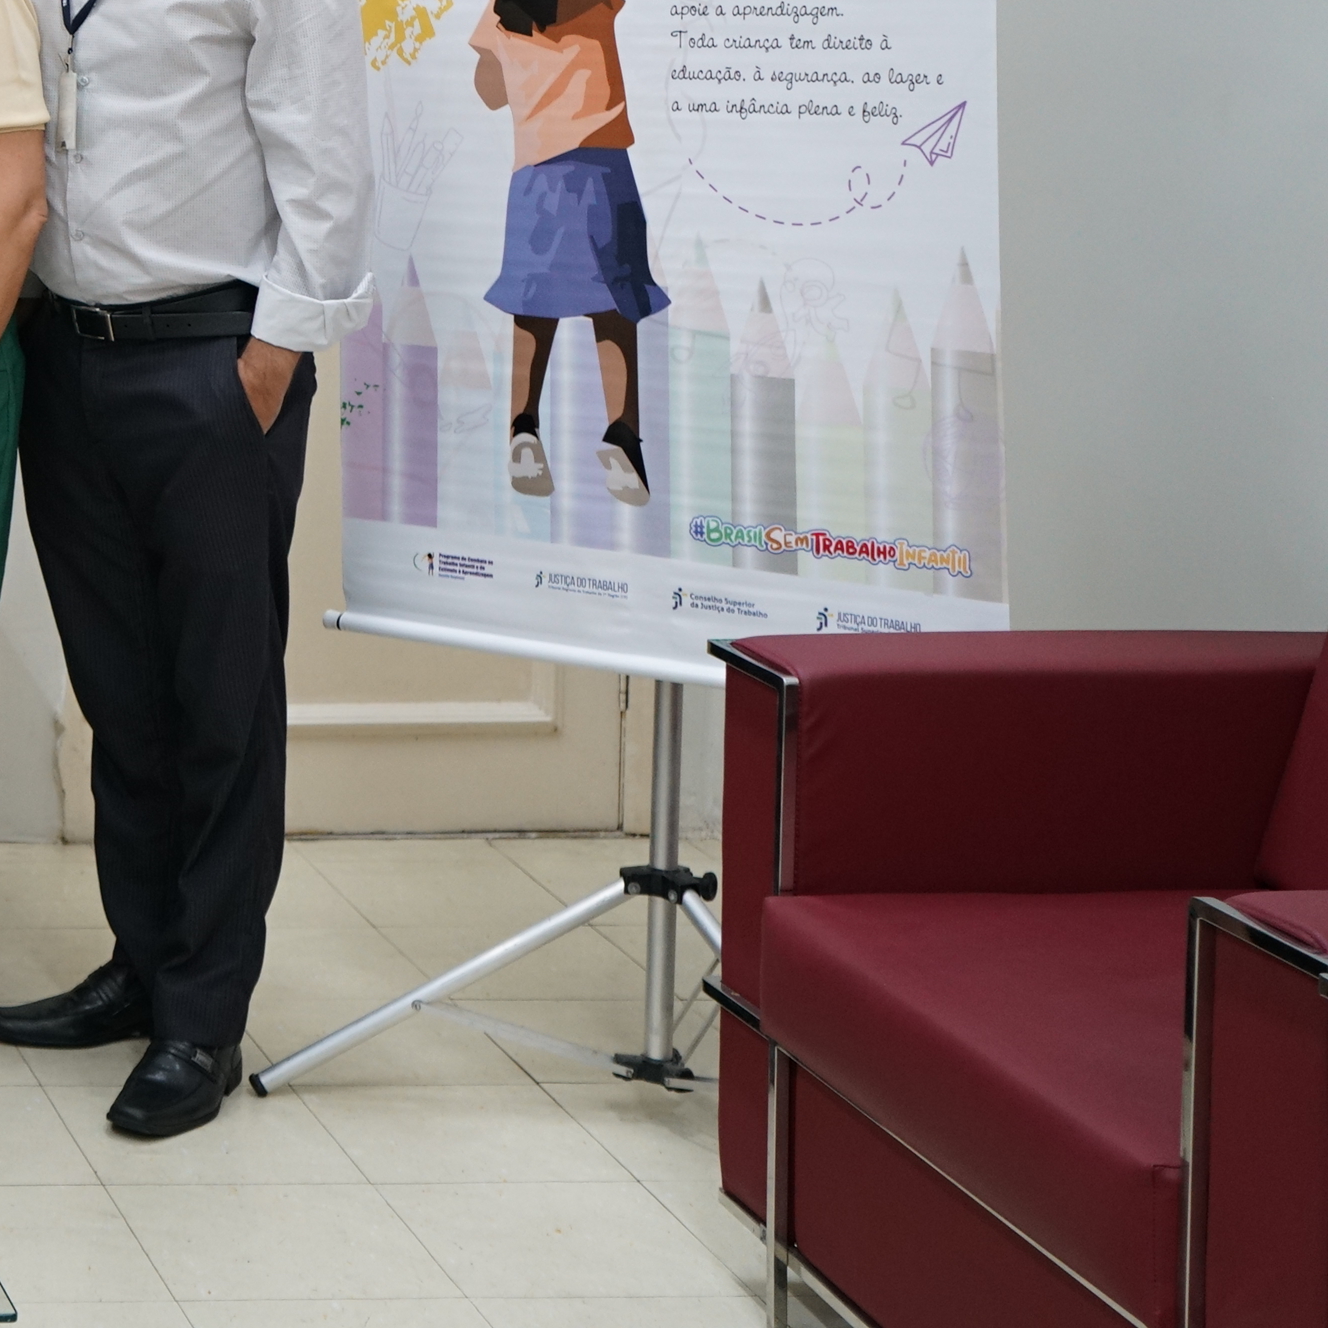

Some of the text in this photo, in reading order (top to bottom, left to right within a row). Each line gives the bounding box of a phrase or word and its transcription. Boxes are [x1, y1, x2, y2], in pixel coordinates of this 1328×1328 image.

[670, 1, 844, 25] apoie a aprendizagem.
[670, 30, 892, 53] Toda criança tem direito à
[753, 66, 765, 83] à
[862, 72, 881, 84] ao
[888, 68, 929, 92] lazer
[936, 73, 945, 85] e
[671, 97, 903, 125] a uma infância plena e feliz.
[548, 573, 629, 594] JUSTIÇA DO TRABALHO
[690, 593, 755, 609] Conselho Superior
[700, 603, 724, 614] Justiça
[737, 608, 768, 619] Trabalho
[836, 612, 921, 633] JUSTIÇA DO TRABALHO
